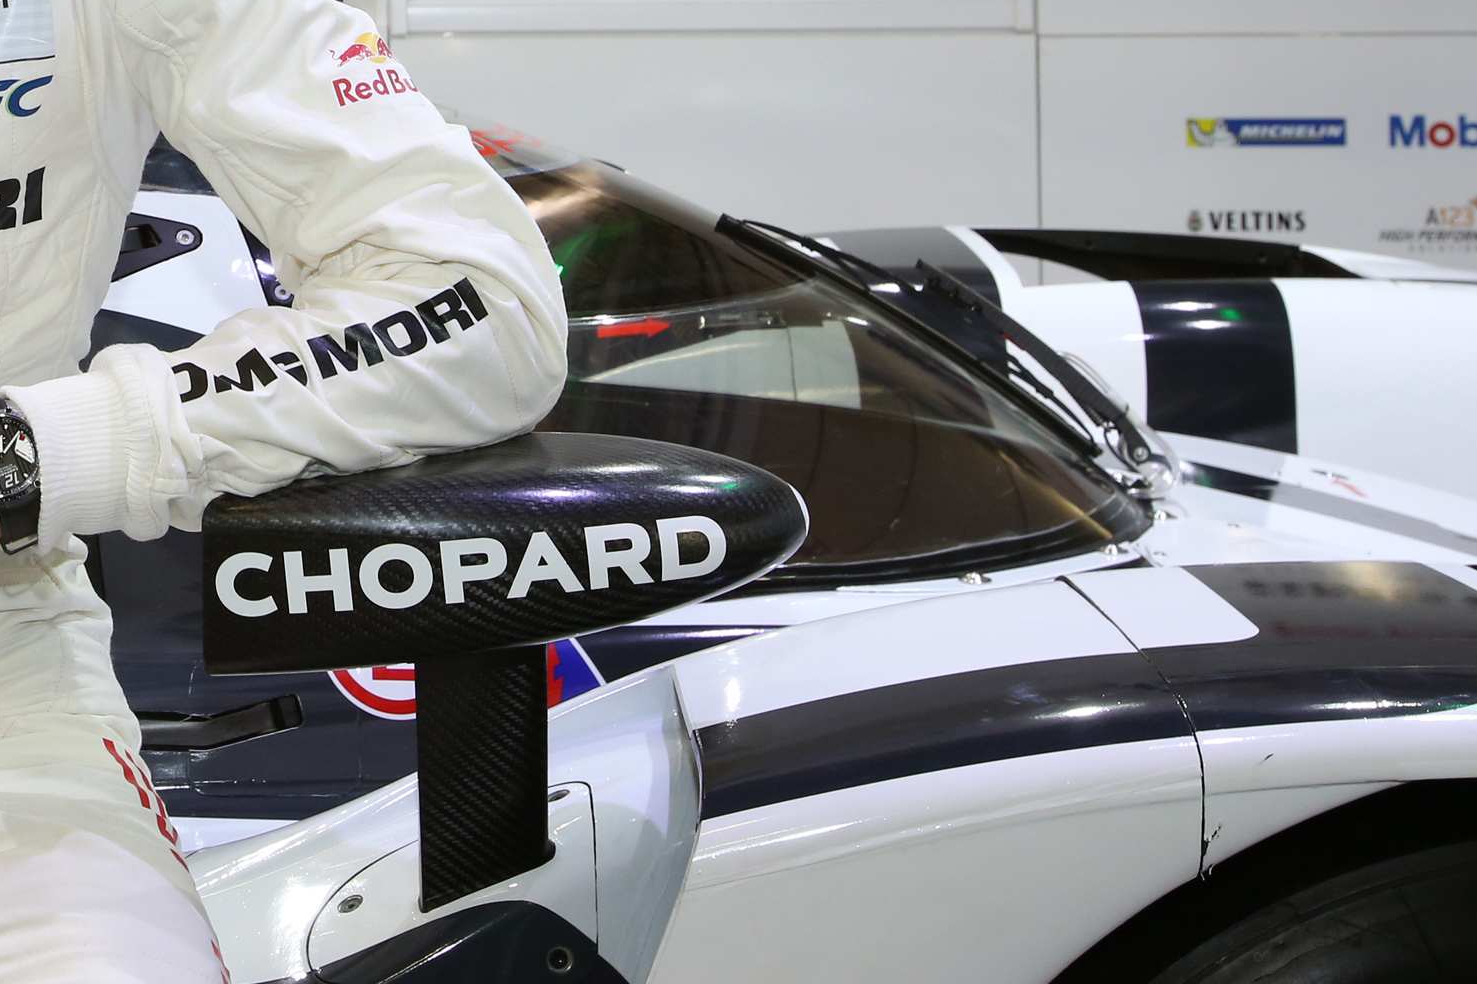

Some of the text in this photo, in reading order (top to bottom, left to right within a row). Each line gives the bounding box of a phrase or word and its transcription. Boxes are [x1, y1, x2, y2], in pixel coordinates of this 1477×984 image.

[1239, 123, 1344, 139] MICHELIN
[1209, 209, 1307, 232] VELTINS
[306, 276, 489, 381] MORI
[4, 471, 20, 489] 12
[214, 514, 728, 617] CHOPARD
